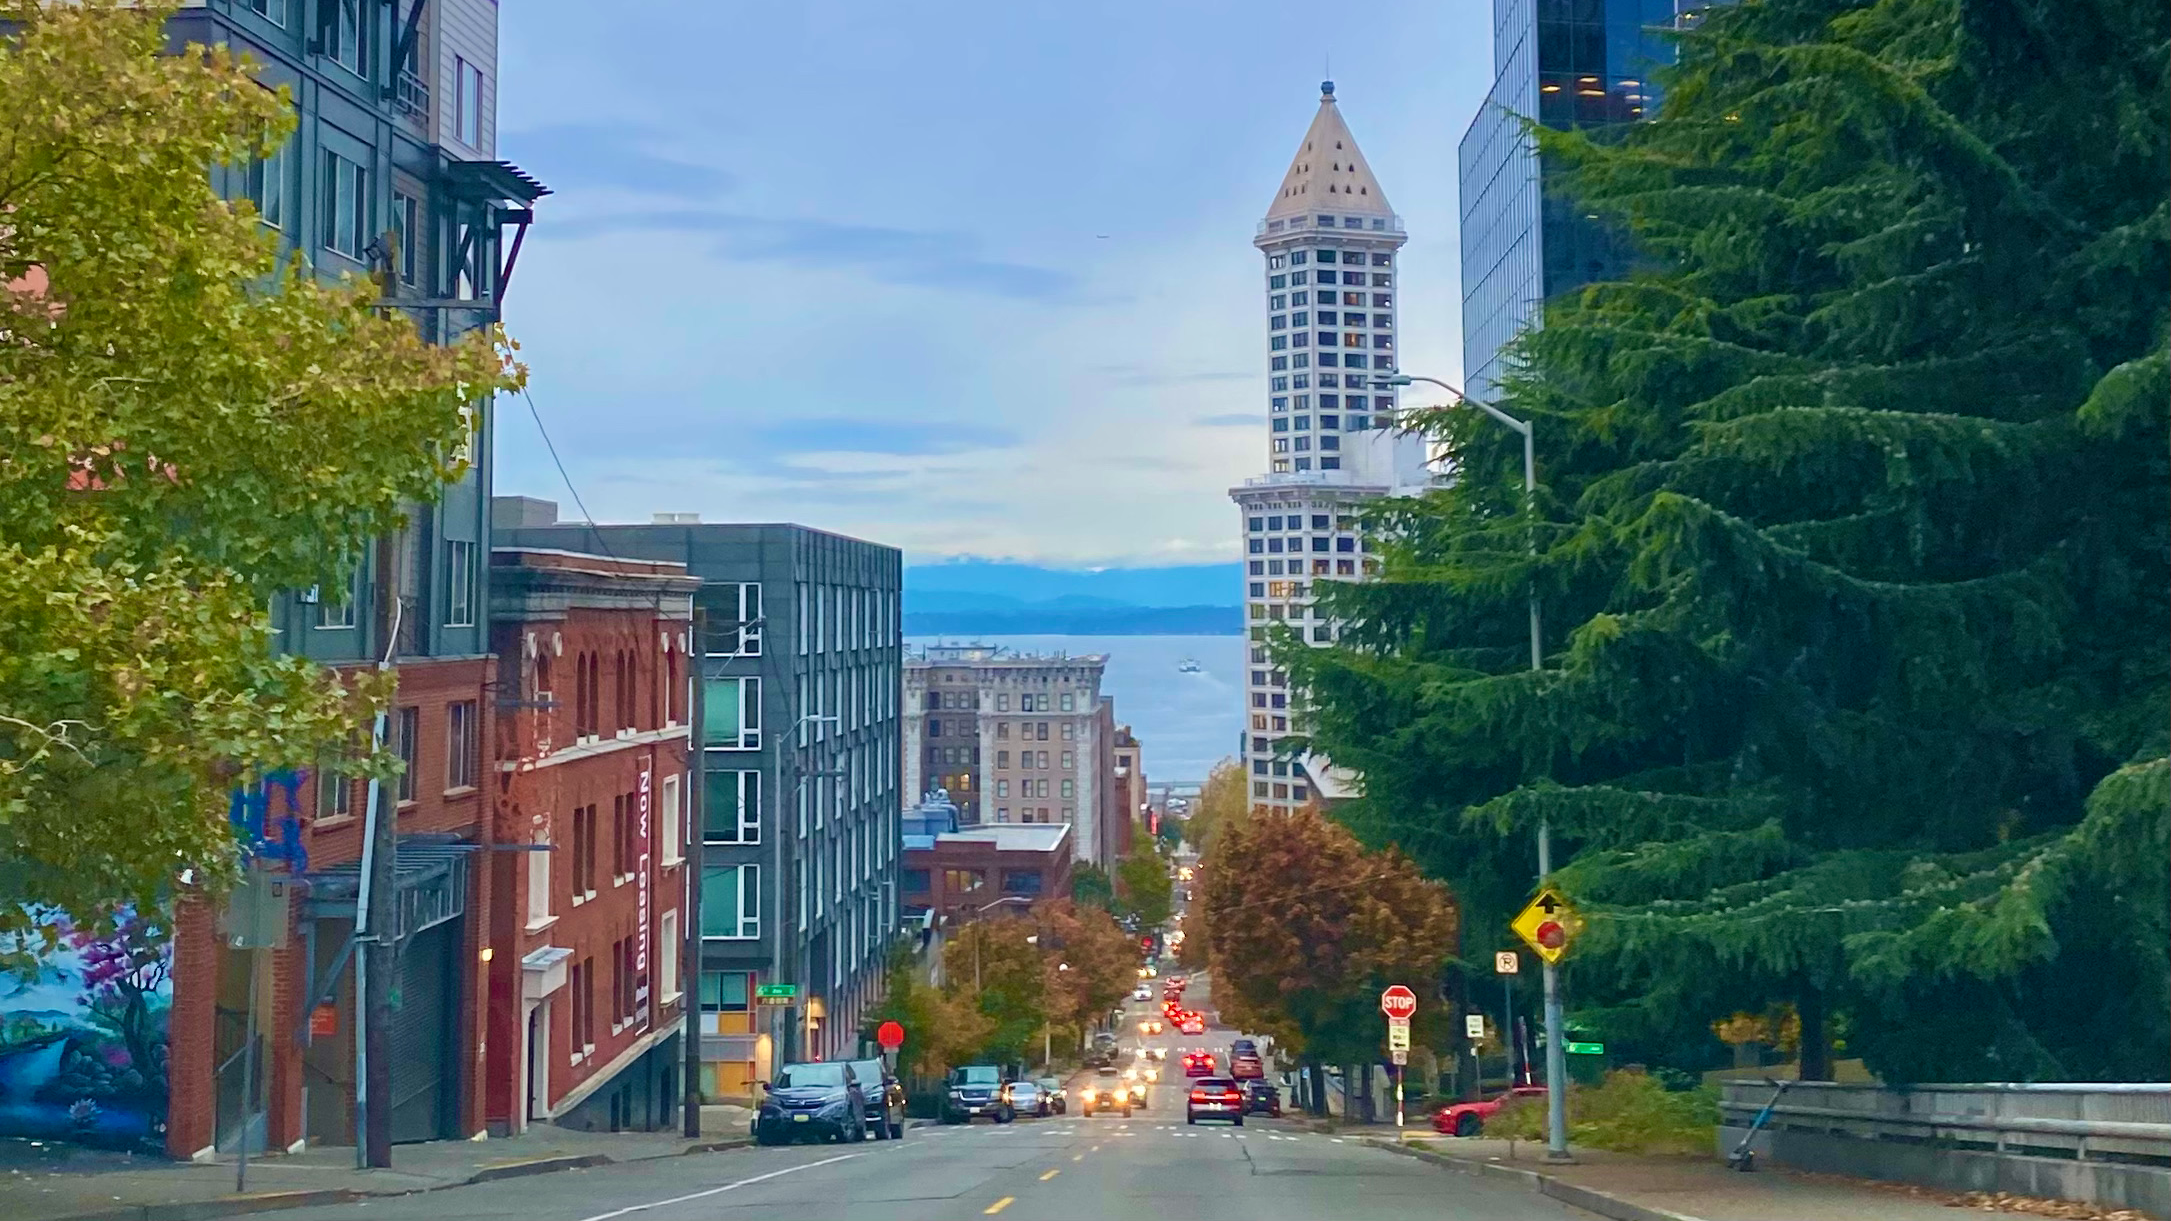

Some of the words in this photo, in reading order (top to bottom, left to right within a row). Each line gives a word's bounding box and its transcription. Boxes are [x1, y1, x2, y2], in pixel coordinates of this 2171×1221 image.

[640, 771, 649, 838] Now
[637, 853, 648, 970] Leasing
[1385, 996, 1414, 1009] STOP
